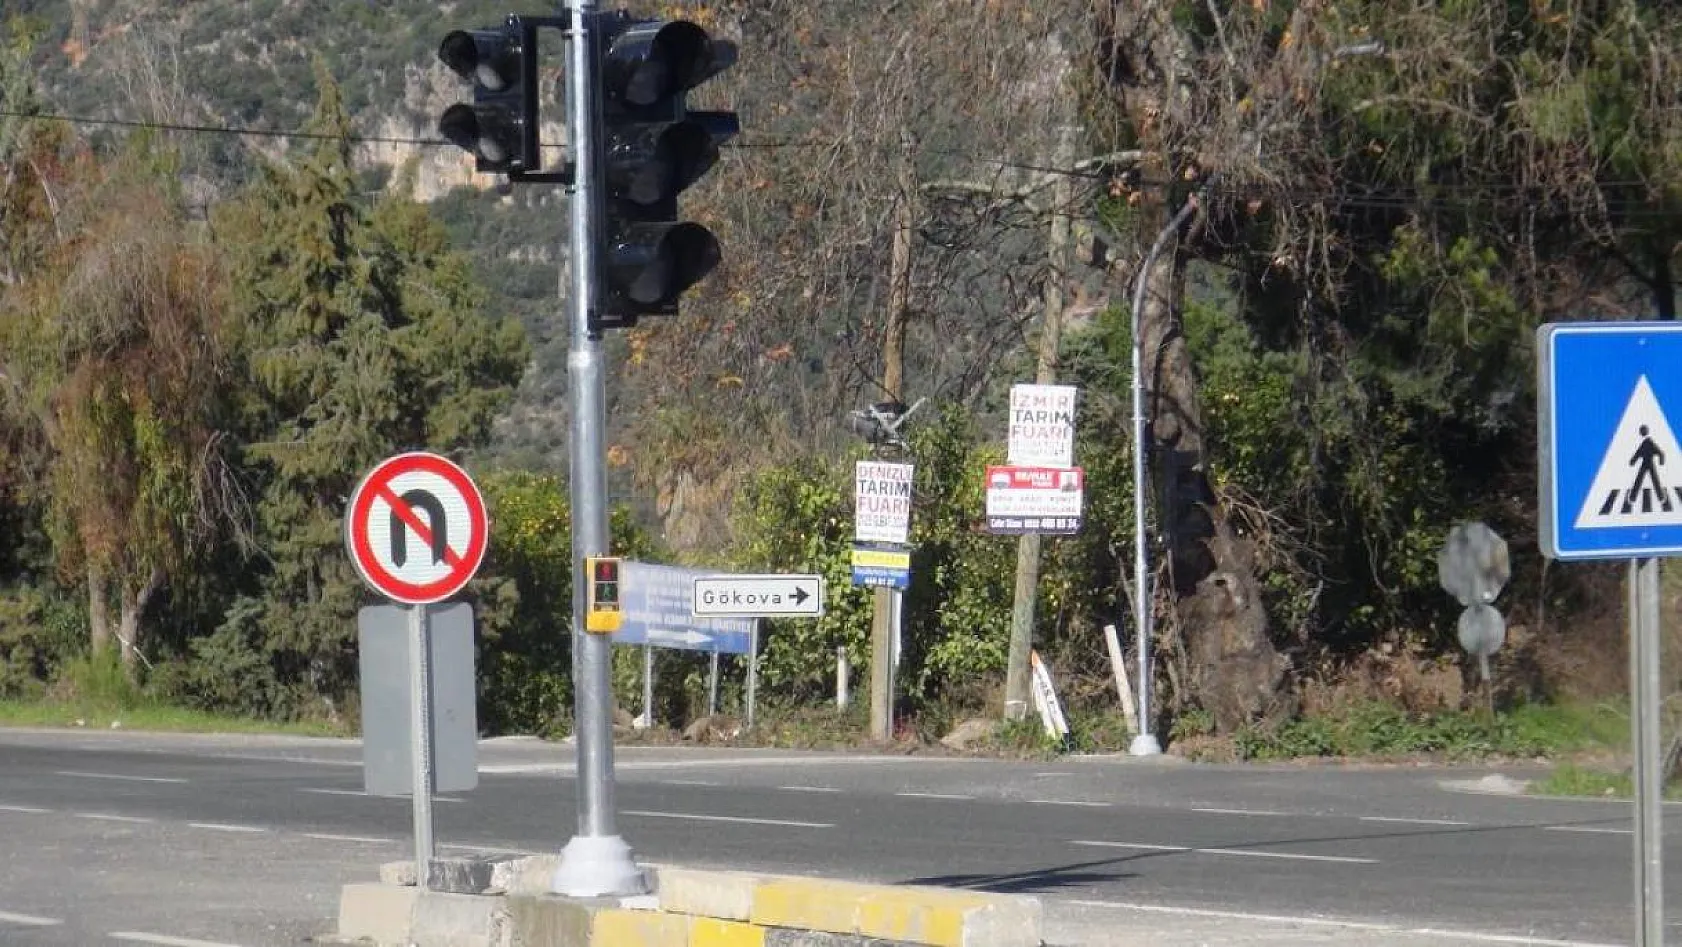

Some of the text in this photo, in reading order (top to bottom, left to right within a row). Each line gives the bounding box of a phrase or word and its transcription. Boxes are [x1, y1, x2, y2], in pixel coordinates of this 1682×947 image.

[1013, 409, 1071, 424] TARIM
[859, 480, 910, 496] TARIM
[703, 589, 782, 605] Gökova
